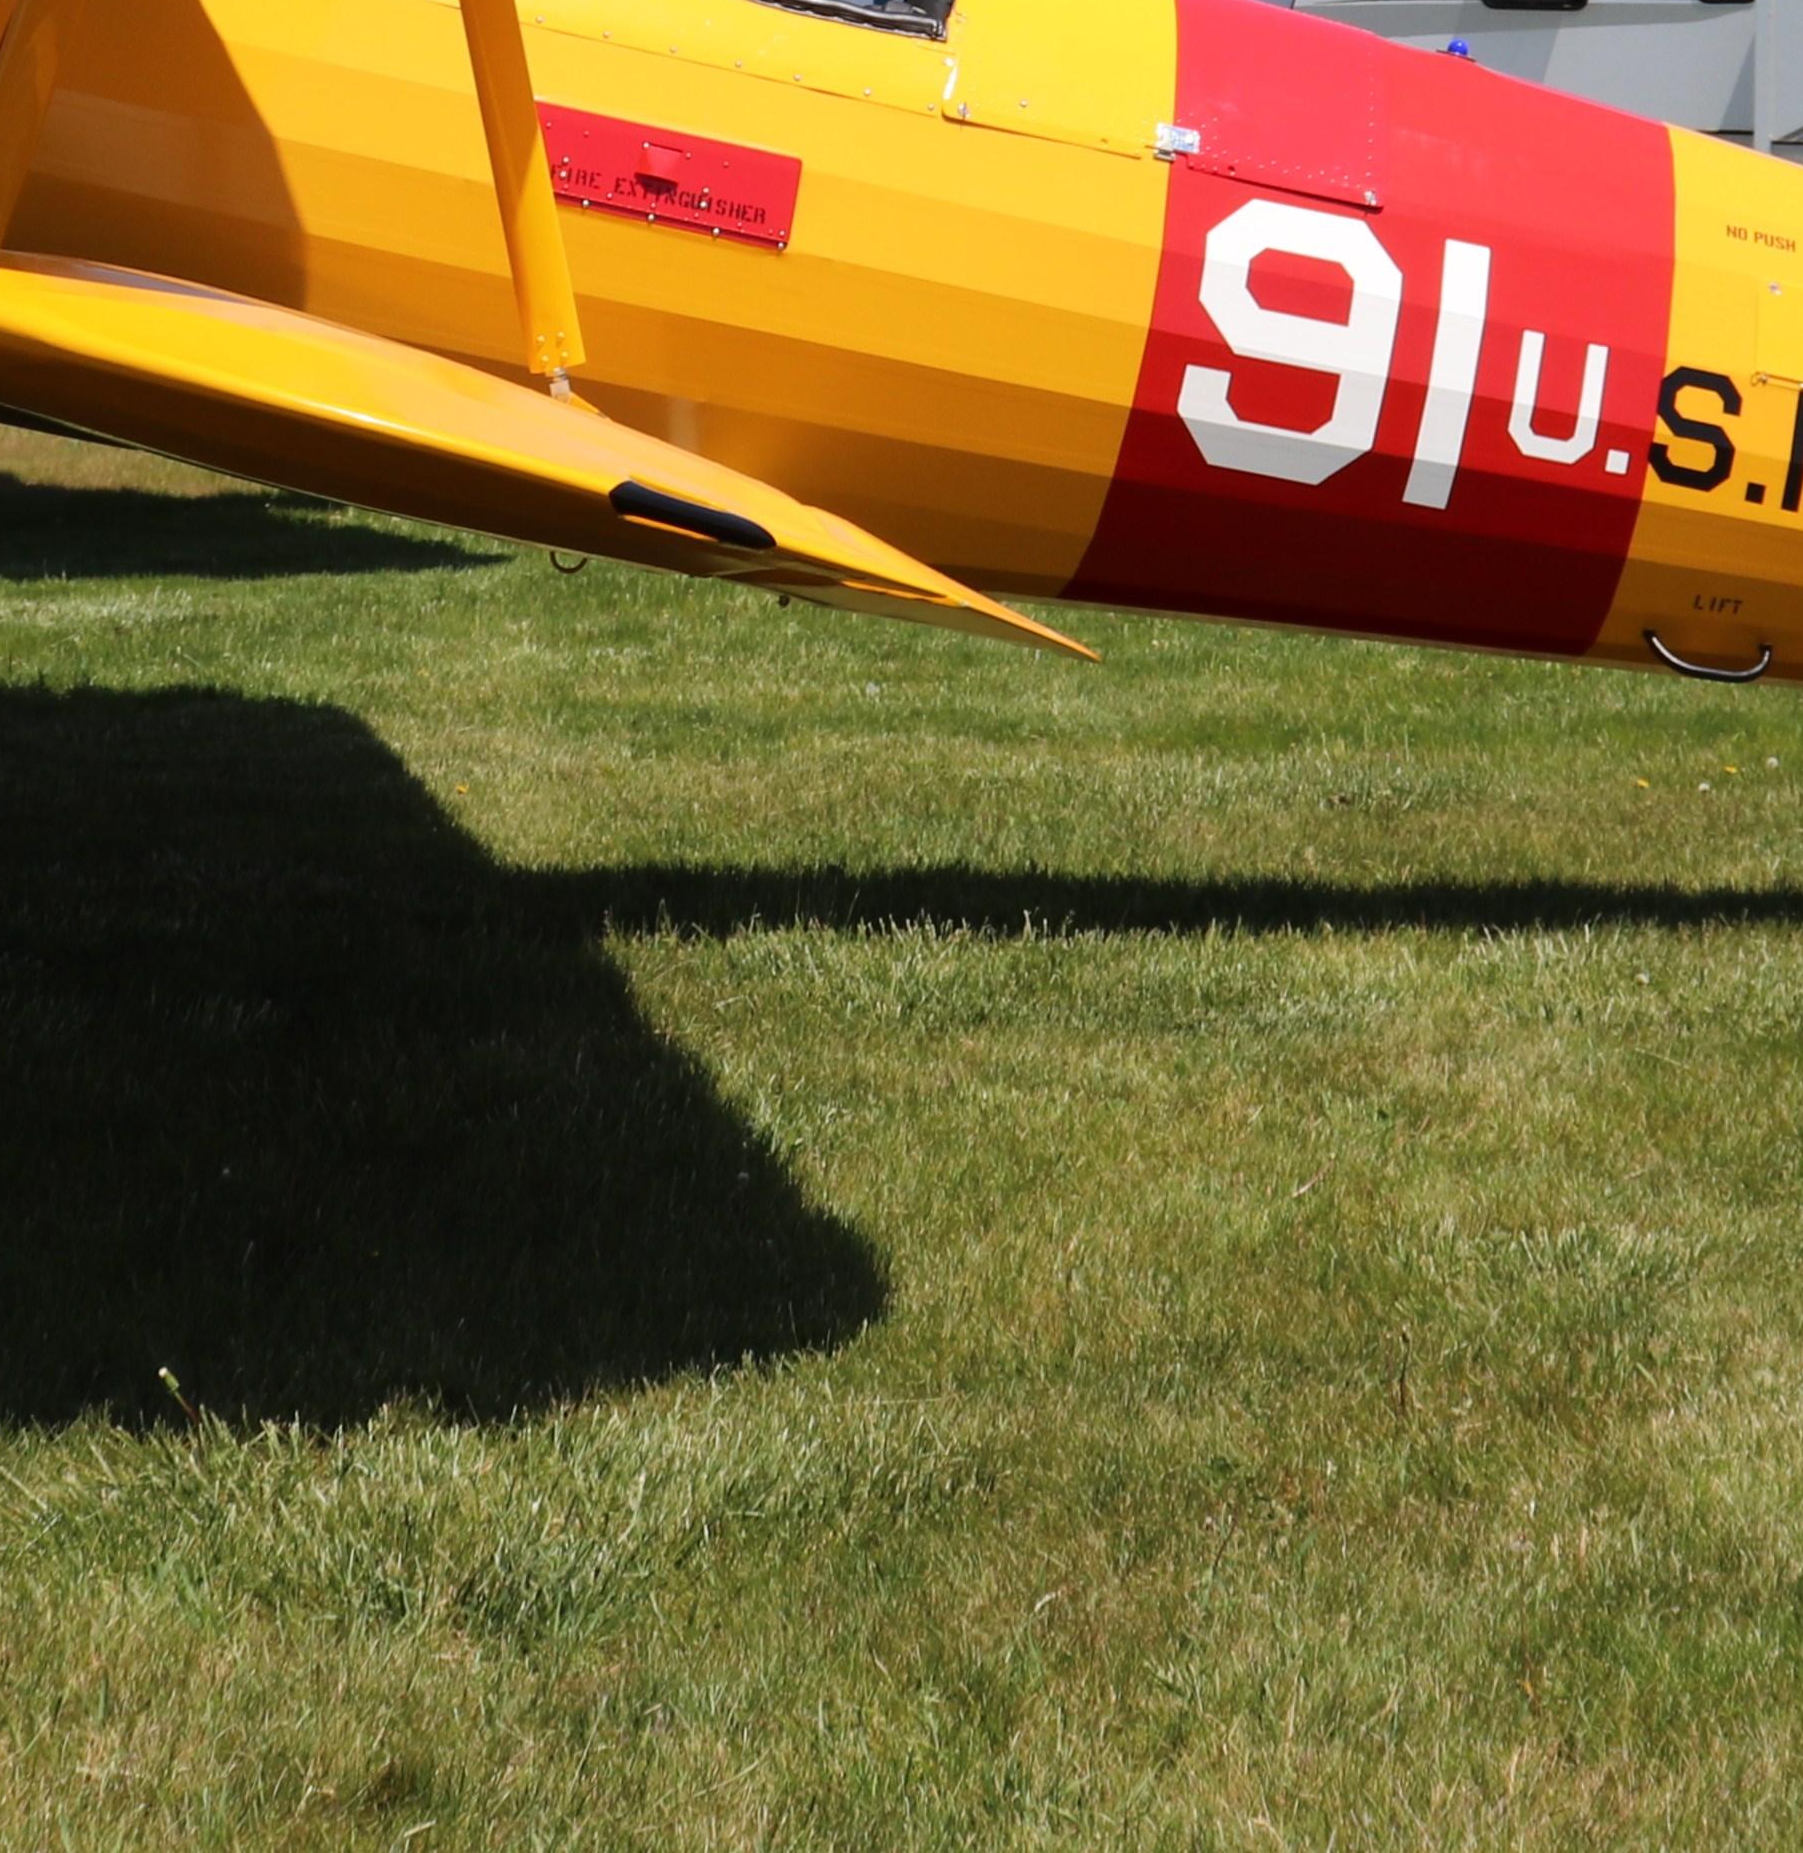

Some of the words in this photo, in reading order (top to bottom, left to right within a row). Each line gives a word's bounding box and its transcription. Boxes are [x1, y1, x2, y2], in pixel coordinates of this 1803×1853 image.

[551, 163, 601, 189] FIRE
[614, 177, 766, 224] EXTINGUISHER
[1726, 224, 1748, 241] NO
[1754, 231, 1796, 253] PUSH
[1177, 198, 1491, 510] 91
[1694, 595, 1743, 615] LIFT
